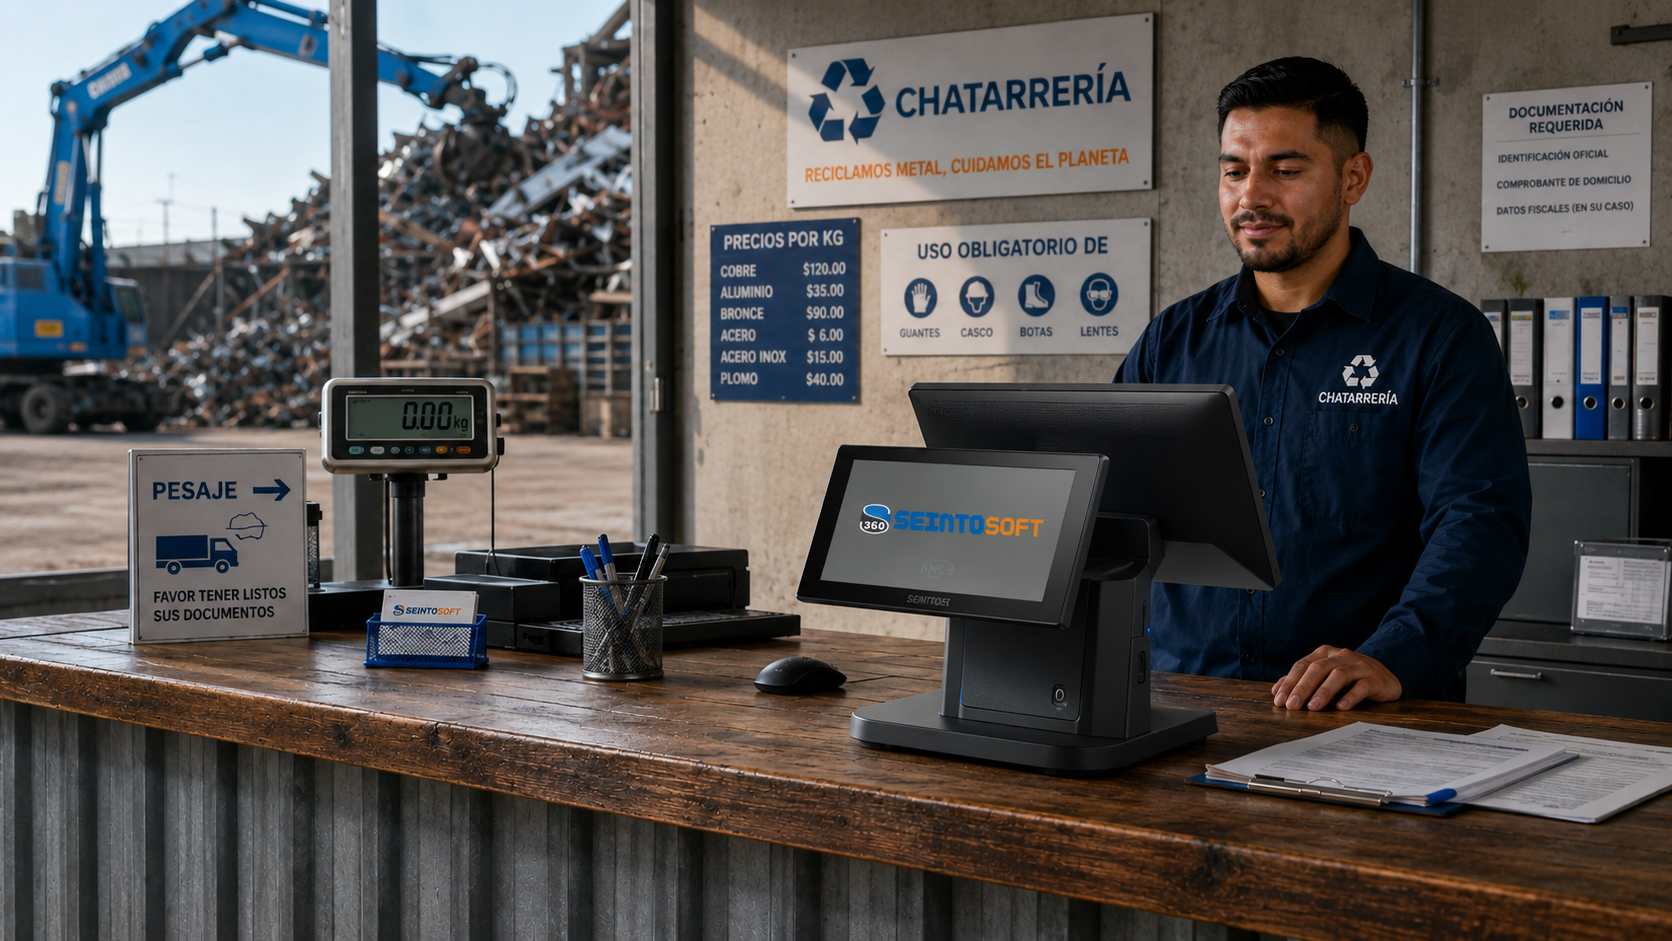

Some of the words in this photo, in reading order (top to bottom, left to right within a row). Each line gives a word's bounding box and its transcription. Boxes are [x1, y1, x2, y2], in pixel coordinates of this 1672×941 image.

[896, 62, 1132, 118] CHATARRERÍA
[1508, 97, 1624, 119] DOCUMENTACIÓN
[1529, 118, 1604, 134] REQUERIDA
[1498, 149, 1571, 164] IDENTIFICACIÓN
[1573, 149, 1609, 160] OFICIAL
[805, 162, 893, 183] RECICLAMOS
[896, 160, 947, 178] METAL,
[951, 153, 1031, 174] CUIDAMOS
[1035, 153, 1054, 169] EL
[1058, 148, 1130, 168] PLANETA
[1496, 177, 1566, 189] COMPROBANTE
[1568, 177, 1581, 187] DE
[1583, 174, 1632, 186] DOMICILIO
[1496, 205, 1526, 216] DATOS
[1528, 203, 1570, 214] FISCALES
[1572, 203, 1588, 214] (EN
[1589, 202, 1602, 212] SU
[1604, 201, 1634, 212] CASO)
[723, 232, 785, 251] PRECIOS
[788, 230, 819, 248] POR
[823, 229, 844, 246] KG
[917, 242, 952, 260] USO
[957, 237, 1078, 259] OBLIGATORIO
[1084, 236, 1109, 255] DE
[720, 264, 757, 278] COBRE
[803, 261, 847, 277] $120.00
[720, 285, 774, 299] ALUMINIO
[806, 283, 845, 299] $35.00
[720, 306, 764, 320] BRONCE
[806, 305, 845, 321] $90.00
[720, 328, 757, 342] ACERO
[899, 328, 940, 338] GUANTES
[960, 327, 993, 338] CASCO
[1020, 326, 1053, 337] BOTAS
[1080, 325, 1119, 337] LENTES
[720, 350, 757, 364] ACERO
[759, 350, 787, 363] INOX
[806, 349, 844, 365] $15.00
[720, 372, 759, 385] PLOMO
[806, 372, 844, 387] $40.00
[1318, 390, 1398, 405] CHATARRERÍA
[402, 401, 453, 430] 0.00
[453, 415, 468, 432] kg
[152, 481, 238, 500] PESAJE
[863, 520, 885, 530] 360
[893, 510, 1045, 537] SEINTOSOFT
[153, 590, 195, 603] FAVOR
[199, 588, 239, 602] TENER
[243, 587, 287, 600] LISTOS
[153, 609, 180, 622] SUS
[184, 605, 275, 621] DOCUMENTOS
[405, 606, 462, 616] SEINTOSOFT
